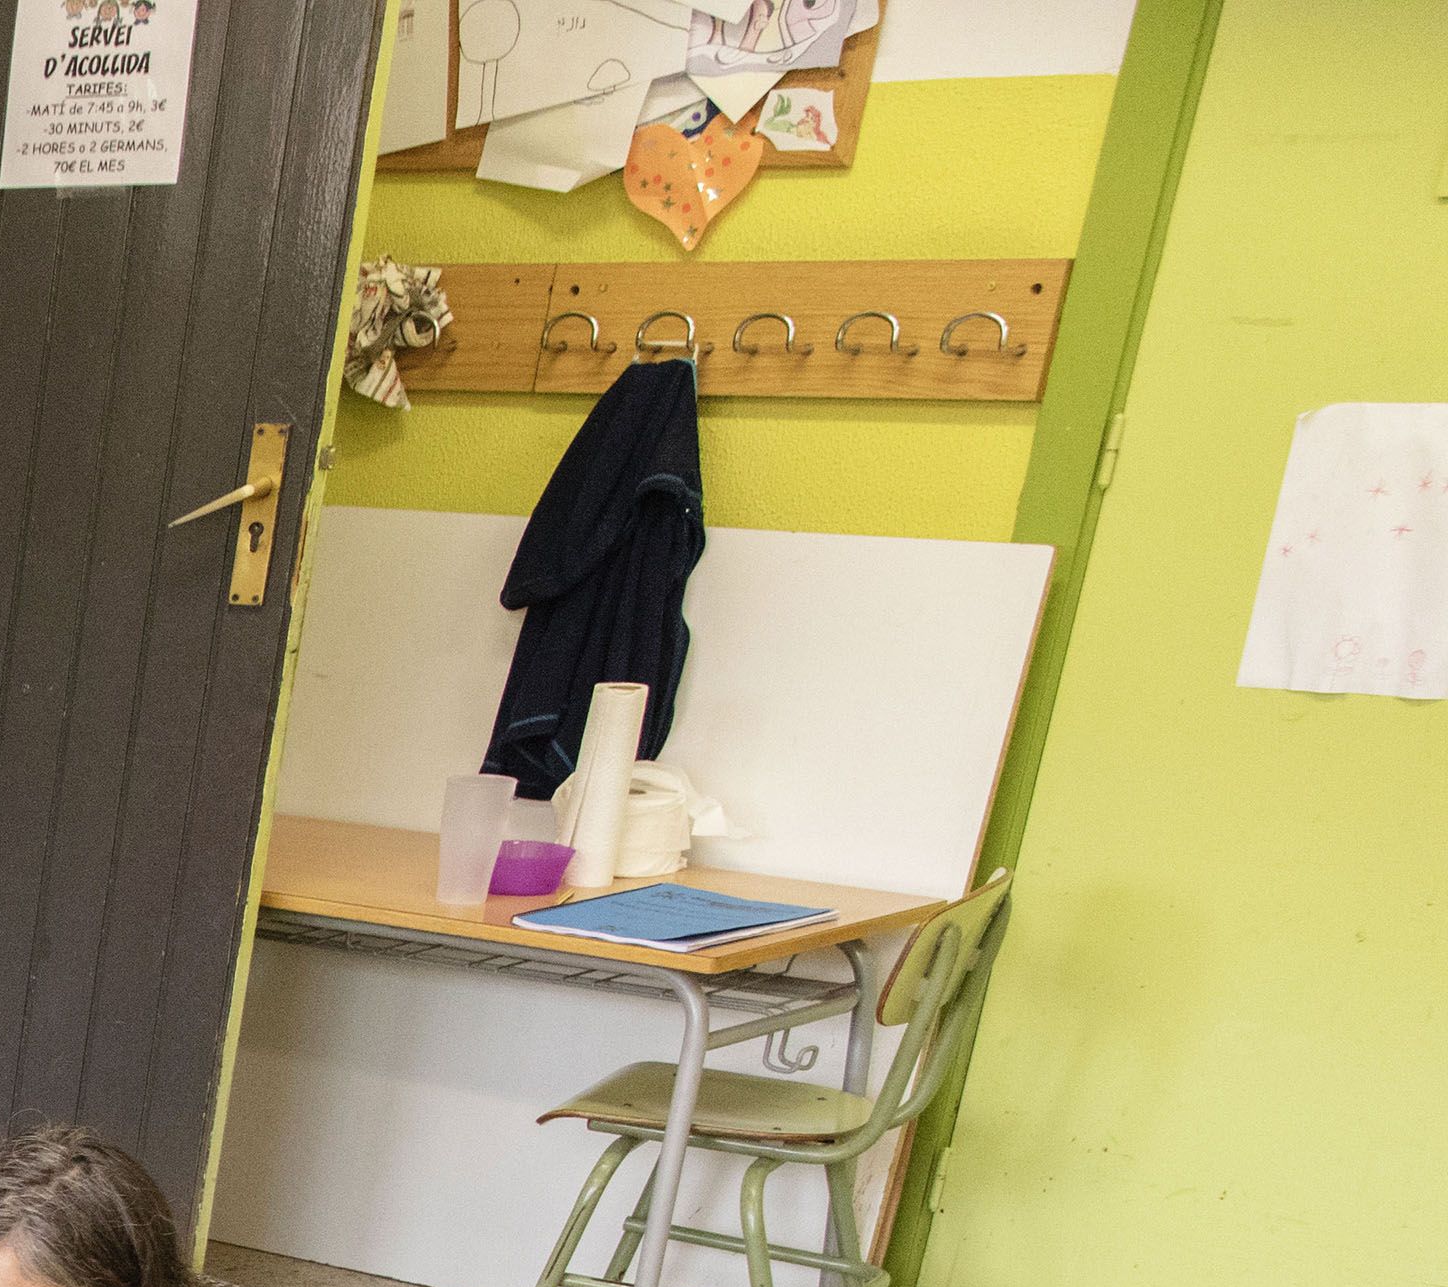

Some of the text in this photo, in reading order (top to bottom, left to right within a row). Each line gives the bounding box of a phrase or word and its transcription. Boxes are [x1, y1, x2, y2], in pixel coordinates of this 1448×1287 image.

[69, 25, 133, 48] SERVEI
[44, 51, 151, 78] D'ACOLLIDA
[66, 82, 128, 97] TARIFES:
[69, 102, 83, 116] de
[87, 101, 115, 115] 7:45
[117, 104, 124, 114] a
[128, 100, 146, 114] 9h,
[151, 99, 168, 113] 3€
[43, 119, 145, 136] -30 MINUTS, 2€
[32, 141, 76, 155] HORES
[79, 144, 86, 154] o
[89, 141, 97, 154] 2
[100, 139, 168, 153] GERMANS,
[54, 159, 126, 173] 70€ EL MES
